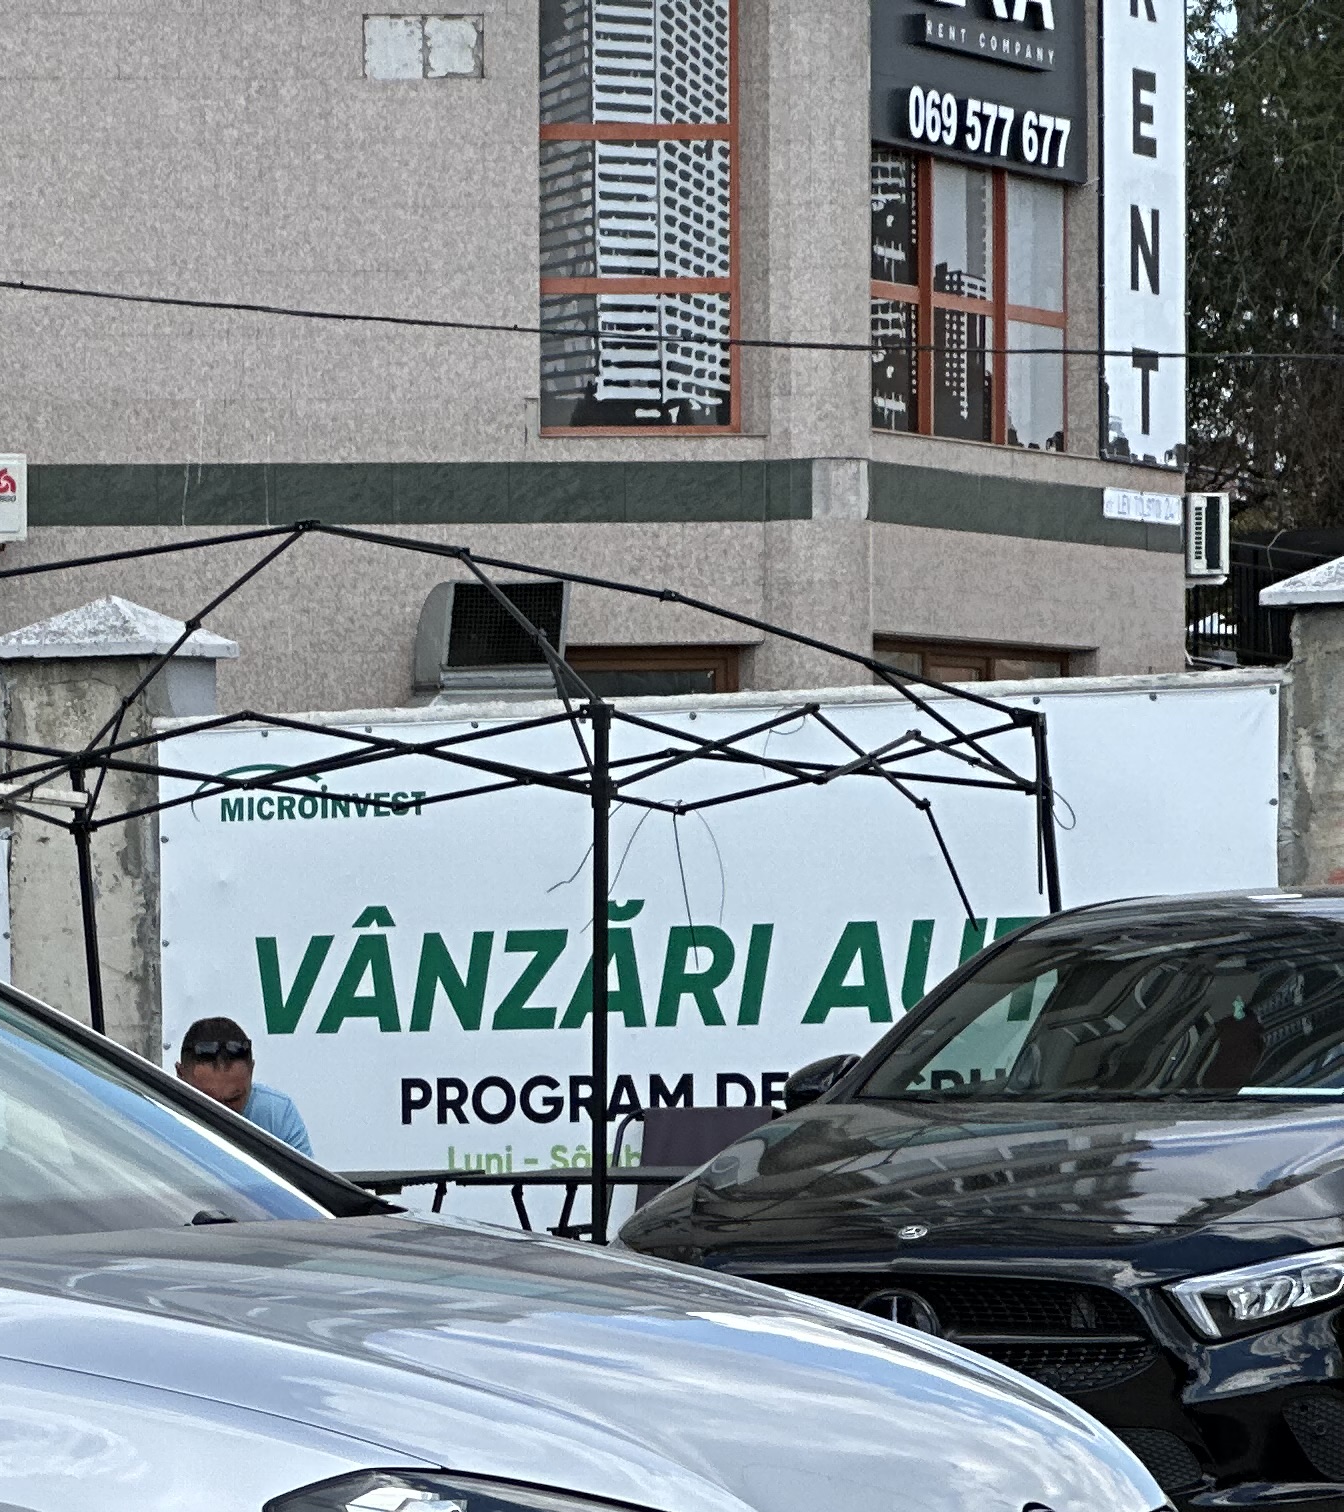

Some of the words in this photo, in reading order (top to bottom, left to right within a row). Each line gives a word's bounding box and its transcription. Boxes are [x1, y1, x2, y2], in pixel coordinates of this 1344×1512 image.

[925, 19, 967, 43] RENT
[978, 32, 1055, 65] COMPANY
[908, 85, 958, 146] 069
[965, 98, 1015, 157] 577
[1022, 110, 1071, 168] 677
[1128, 0, 1161, 436] ENT
[255, 899, 775, 1035] VÂNZĂRI
